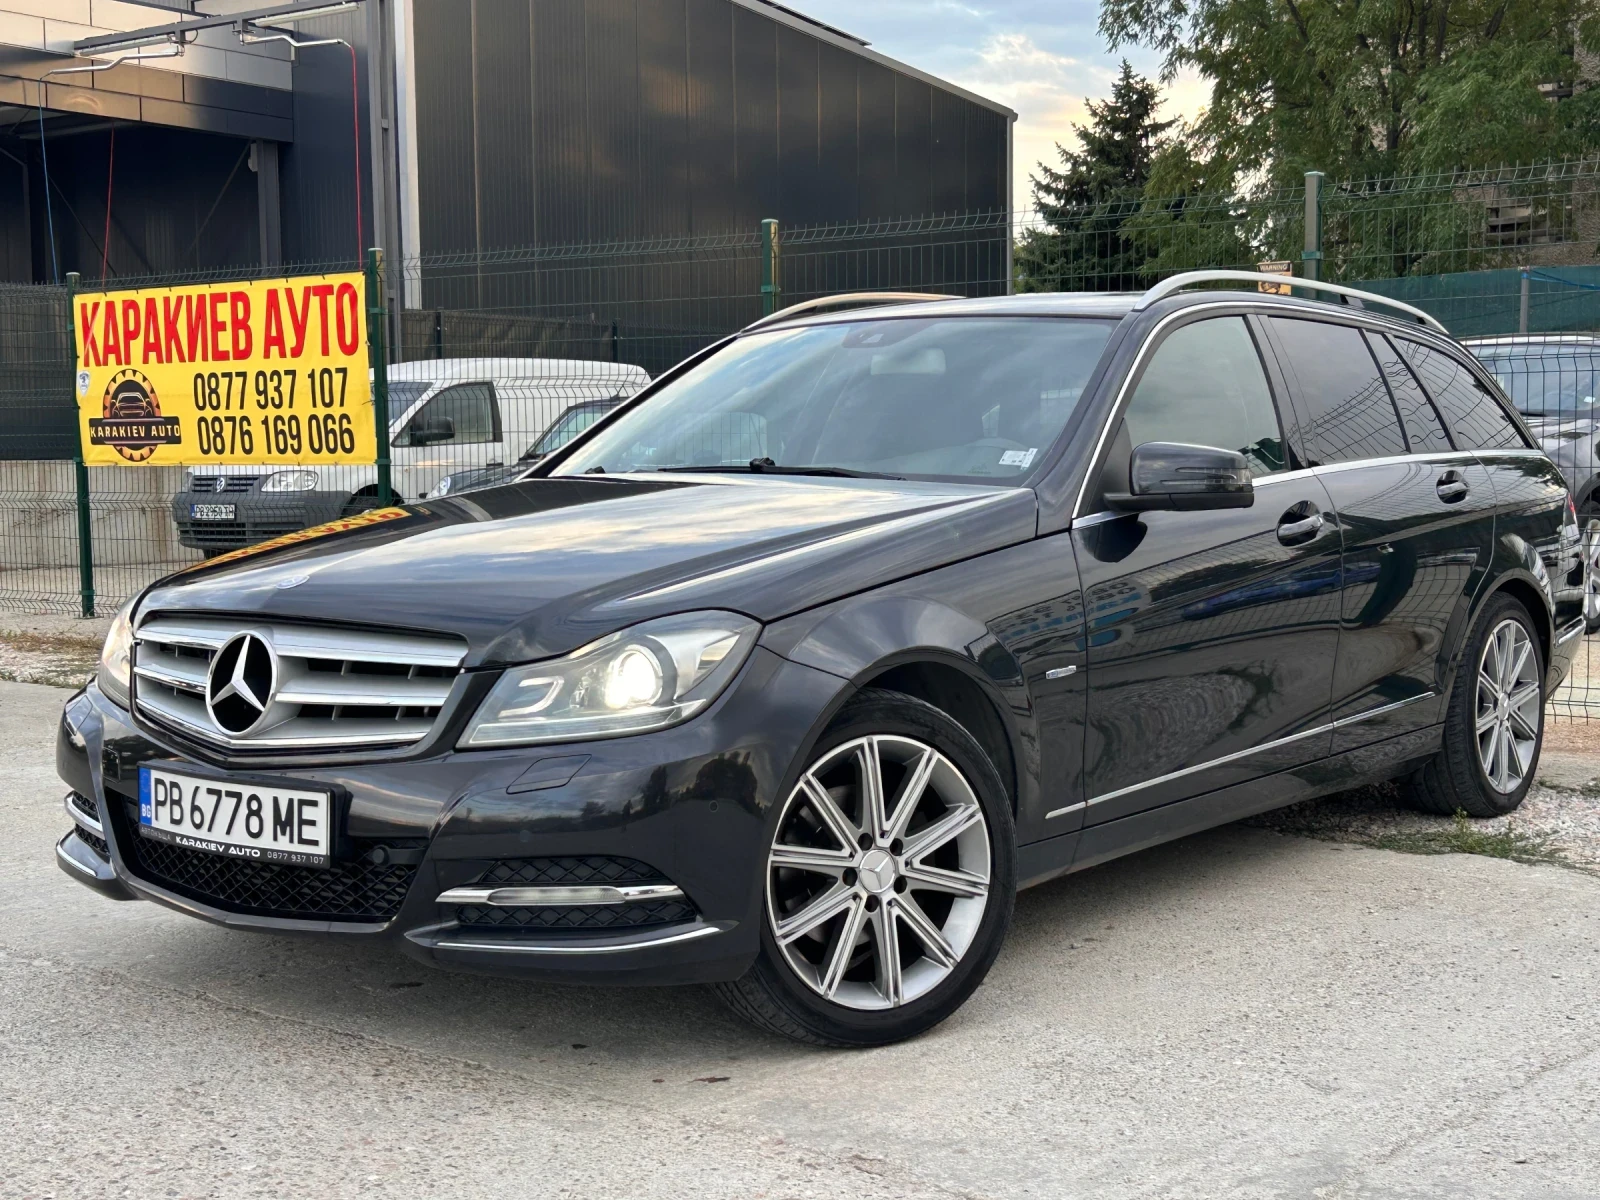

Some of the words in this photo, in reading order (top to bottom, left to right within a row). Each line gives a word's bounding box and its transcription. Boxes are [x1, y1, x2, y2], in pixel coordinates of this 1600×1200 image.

[80, 291, 252, 367] КАРАКИЕВ
[263, 282, 358, 359] АУТО
[193, 371, 247, 410] 0877
[255, 369, 297, 409] 937
[307, 367, 348, 408] 107
[90, 425, 145, 437] KARAKIEV
[151, 425, 180, 437] AUTO
[197, 416, 254, 455] 0876
[262, 415, 301, 454] 169
[307, 413, 355, 454] 066
[141, 803, 151, 818] BG
[175, 835, 225, 852] KARAKIEV
[228, 846, 260, 857] AUTO
[267, 851, 288, 860] 0877
[291, 854, 306, 862] 937
[309, 855, 324, 865] 107
